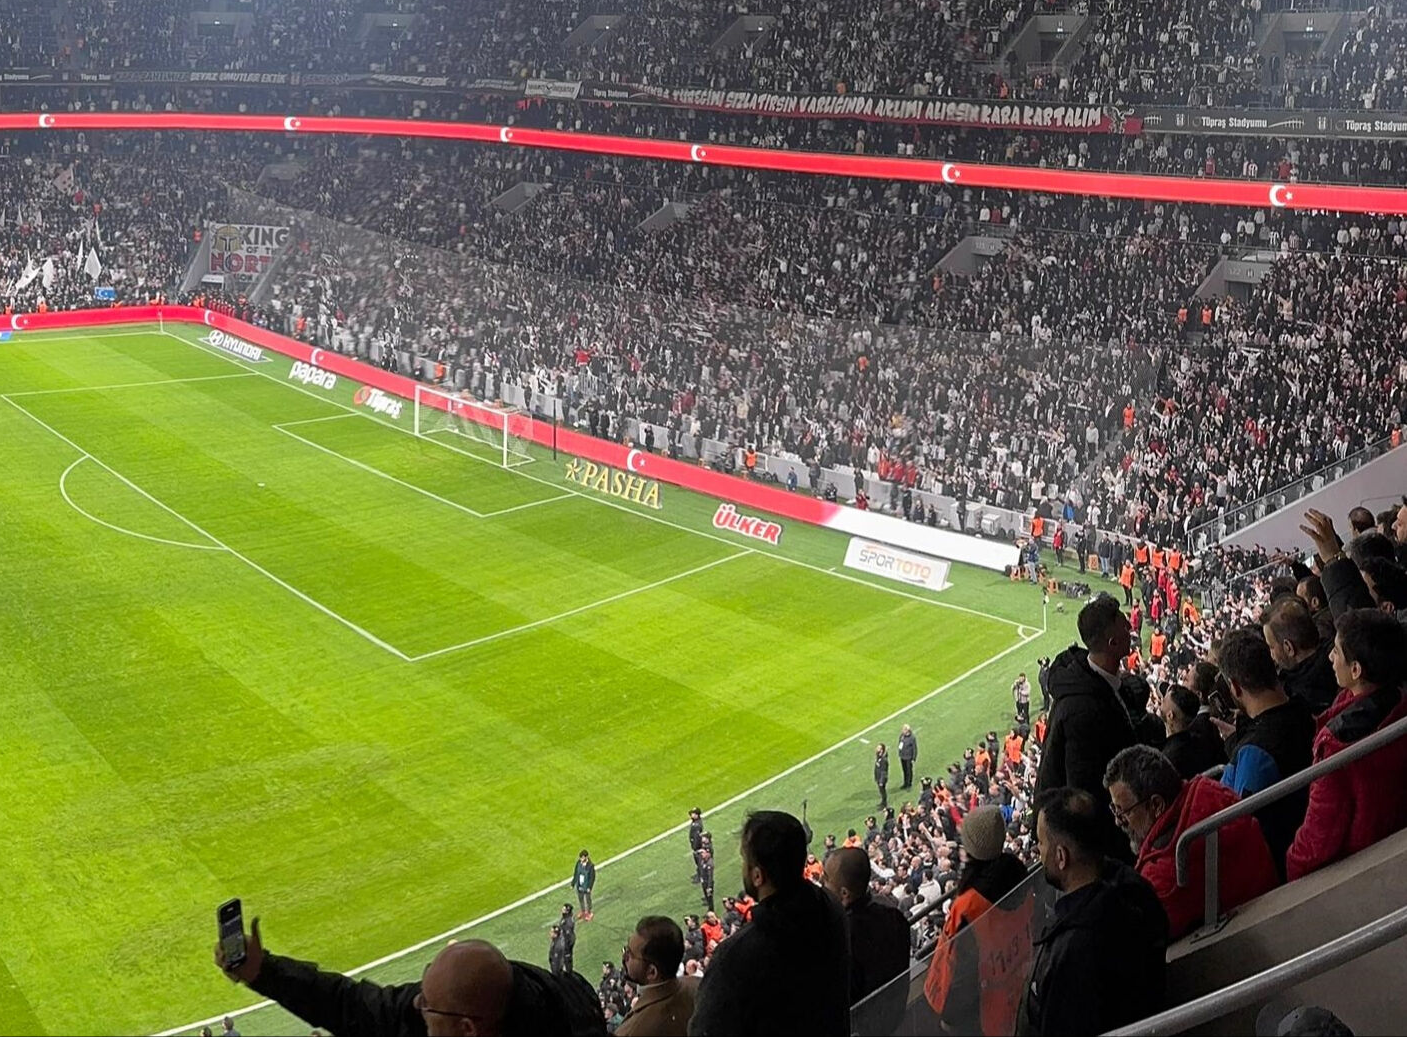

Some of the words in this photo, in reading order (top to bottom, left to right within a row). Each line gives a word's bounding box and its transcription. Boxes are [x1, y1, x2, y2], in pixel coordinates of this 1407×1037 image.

[980, 104, 1021, 125] KARA
[1023, 105, 1101, 128] KARTALIM
[1201, 116, 1226, 129] Tüpraş
[1228, 116, 1268, 129] Stadyumu
[1345, 119, 1371, 133] Tüpraş
[240, 226, 290, 247] KING
[210, 252, 273, 273] NORT
[223, 335, 263, 361] HYUNDAI
[289, 362, 337, 391] papara
[583, 460, 661, 509] PASHA
[714, 503, 782, 545] ÜLKER
